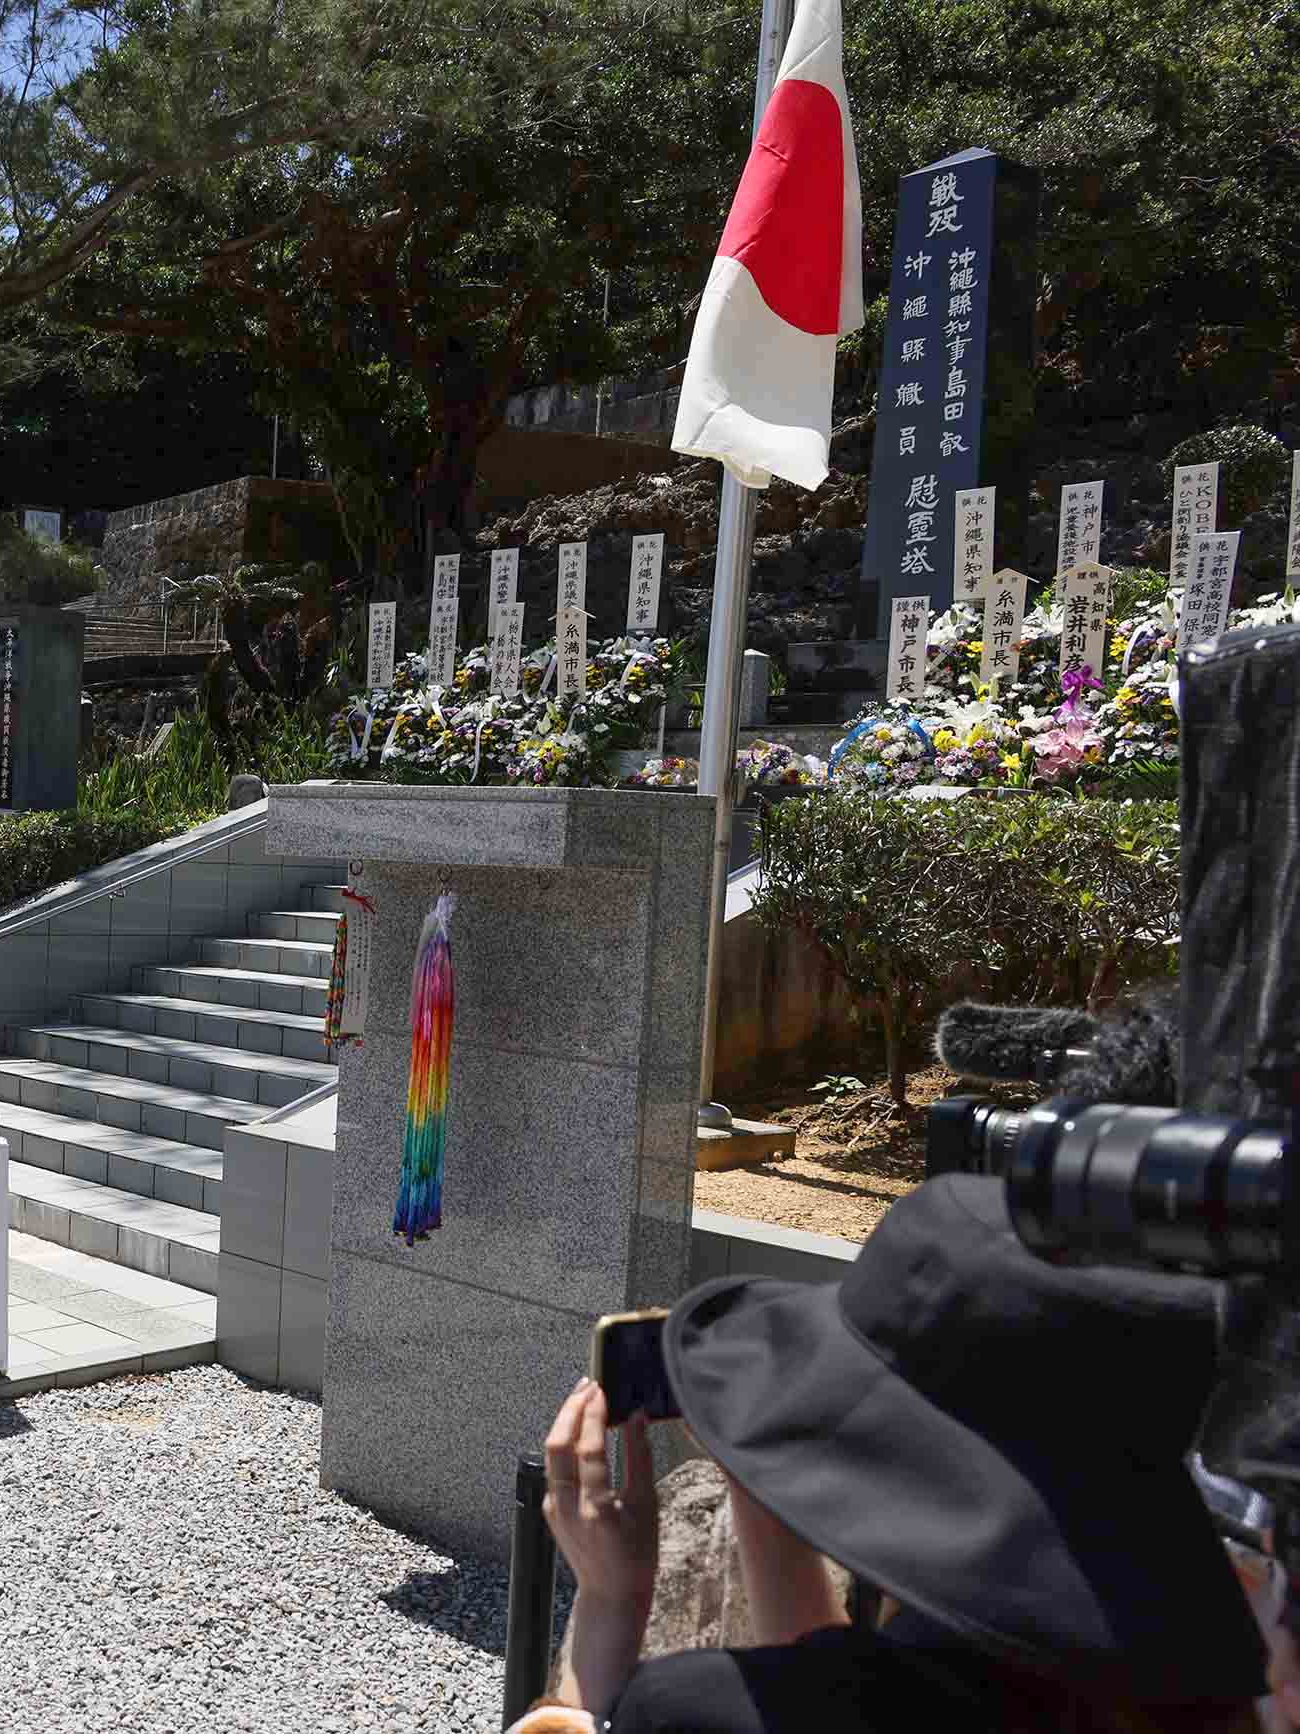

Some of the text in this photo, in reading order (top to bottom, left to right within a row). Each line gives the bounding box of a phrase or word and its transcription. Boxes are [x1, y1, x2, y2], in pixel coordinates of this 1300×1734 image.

[964, 512, 983, 593] 沖縄県知事
[1081, 503, 1098, 556] 神戸市
[635, 555, 654, 623] 沖縄県知事
[1090, 582, 1106, 631] 高知県
[1201, 555, 1229, 640] 宇都宮高校同窓
[504, 621, 519, 688] 栃木県人会
[564, 624, 580, 688] 糸満市長
[896, 614, 920, 693] 神戸市長
[989, 590, 1015, 667] 糸満市長
[1064, 595, 1090, 672] 岩井利彦
